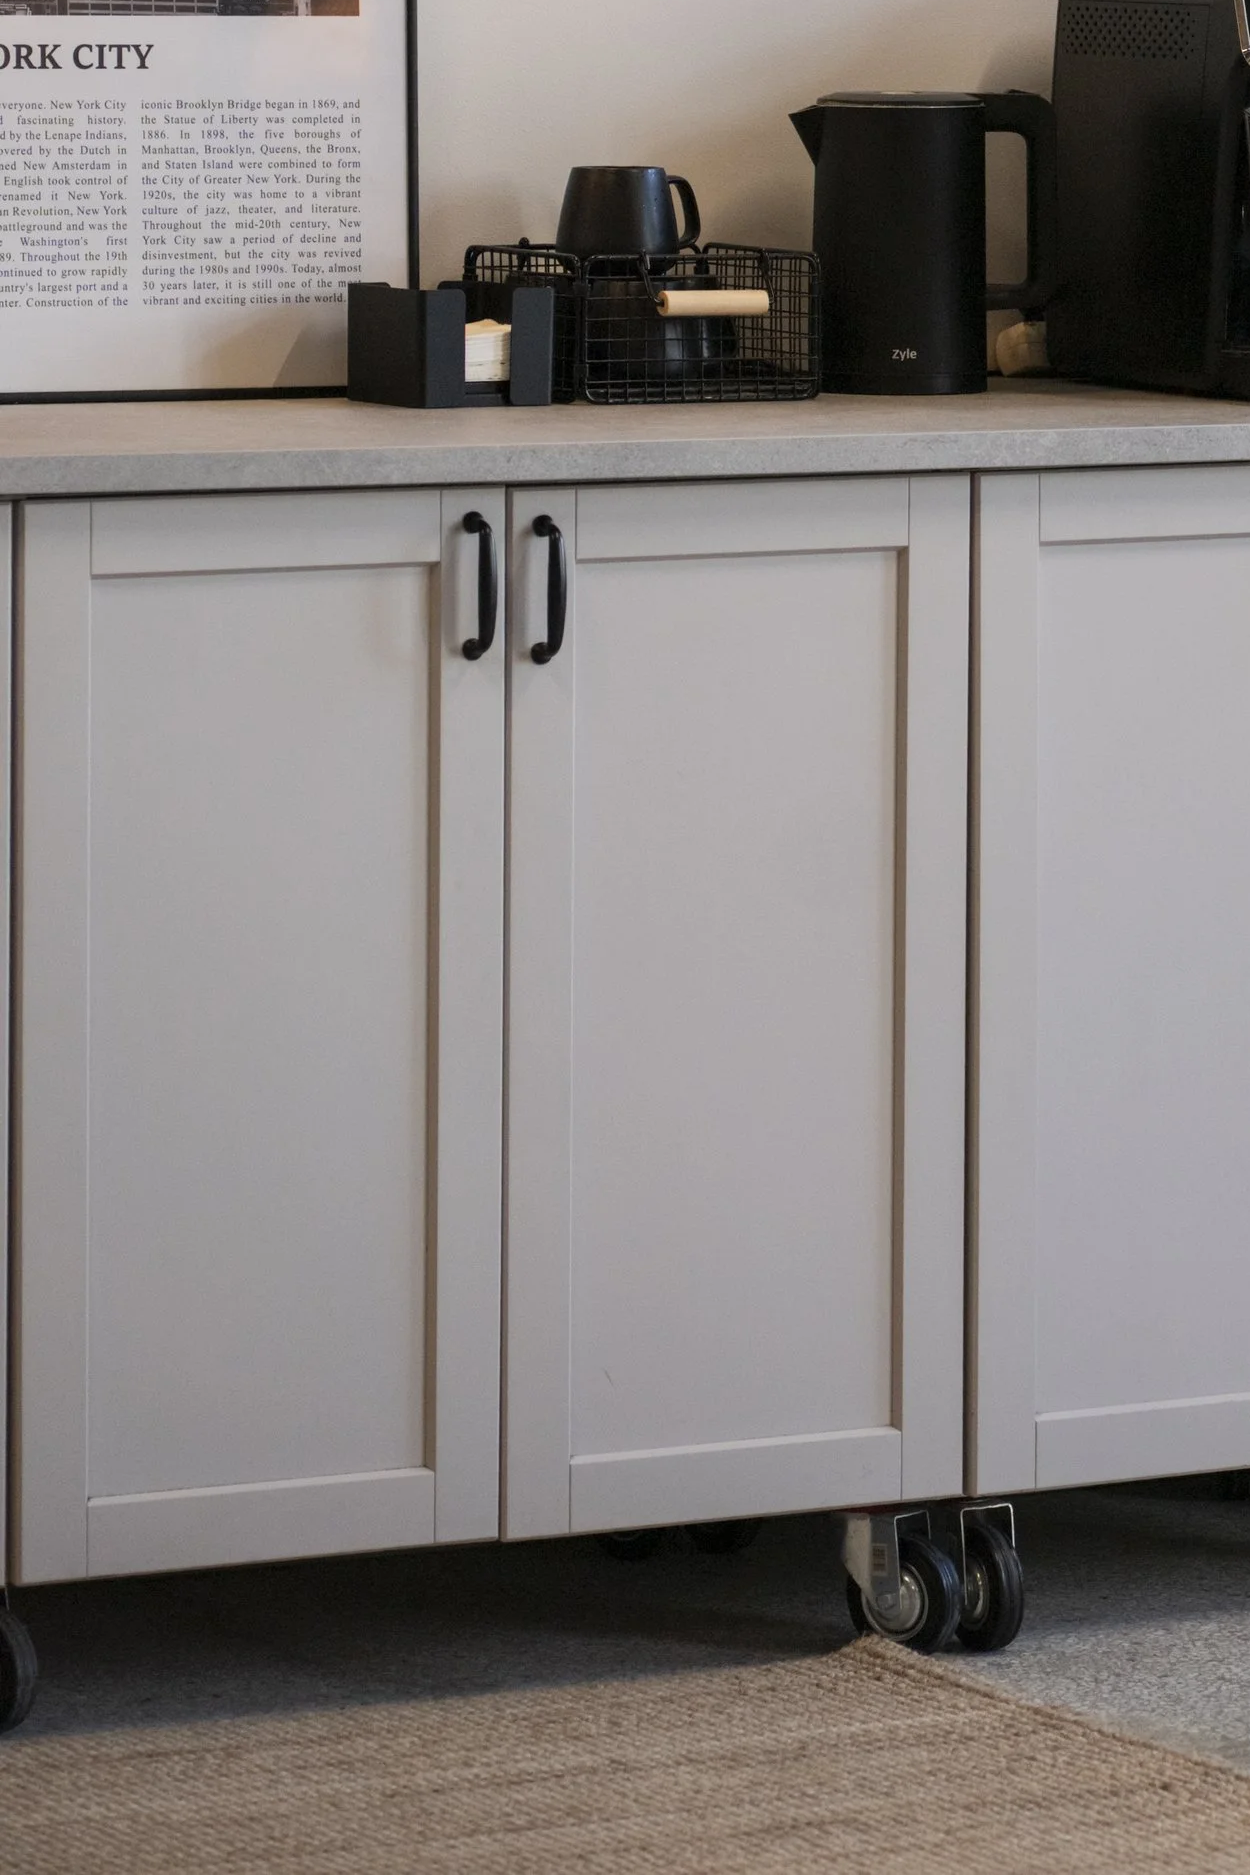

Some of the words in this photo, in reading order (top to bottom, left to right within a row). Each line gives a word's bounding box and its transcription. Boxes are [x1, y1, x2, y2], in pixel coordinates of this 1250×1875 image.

[73, 44, 154, 69] CITY
[51, 100, 72, 109] New
[77, 100, 100, 109] York
[104, 100, 126, 111] City
[142, 99, 172, 109] iconic
[176, 99, 223, 111] Brooklyn
[228, 100, 261, 111] Bridge
[265, 99, 294, 111] began
[313, 99, 339, 109] 1869,
[343, 99, 360, 109] and
[18, 115, 74, 127] fascinating
[88, 115, 125, 127] history.
[141, 115, 156, 124] the
[164, 114, 196, 124] Statue
[203, 114, 215, 124] of
[221, 114, 258, 126] Liberty
[292, 114, 343, 126] completed
[10, 130, 21, 142] by
[26, 130, 41, 140] the
[45, 130, 81, 142] Lenape
[86, 130, 126, 141] Indians,
[143, 130, 169, 139] 1886.
[202, 129, 228, 140] 1898,
[239, 129, 254, 139] the
[265, 129, 284, 139] five
[295, 129, 340, 141] boroughs
[39, 145, 51, 157] by
[58, 145, 73, 155] the
[80, 145, 110, 155] Dutch
[142, 145, 198, 156] Manhattan,
[205, 144, 255, 156] Brooklyn,
[260, 144, 300, 155] Queens,
[306, 144, 321, 153] the
[328, 144, 360, 154] Bronx,
[24, 161, 46, 170] New
[52, 160, 110, 170] Amsterdam
[142, 160, 159, 170] and
[165, 160, 196, 170] Staten
[203, 160, 233, 169] Island
[268, 159, 316, 169] combined
[338, 159, 360, 168] form
[4, 176, 43, 188] English
[48, 176, 70, 185] took
[75, 175, 111, 185] control
[117, 175, 128, 185] of
[142, 175, 157, 185] the
[162, 175, 184, 187] City
[189, 175, 200, 185] of
[204, 174, 242, 184] Greater
[247, 174, 269, 184] New
[274, 174, 300, 183] York.
[306, 174, 341, 185] During
[346, 173, 360, 183] the
[68, 191, 90, 201] New
[100, 191, 127, 200] York.
[144, 190, 175, 200] 1920s,
[184, 190, 199, 200] the
[207, 190, 225, 201] city
[260, 189, 287, 199] home
[326, 189, 360, 198] vibrant
[13, 206, 73, 217] Revolution,
[77, 206, 99, 216] New
[103, 205, 127, 215] York
[142, 205, 178, 215] culture
[206, 205, 229, 216] jazz,
[239, 205, 276, 214] theater,
[285, 204, 302, 213] and
[312, 204, 360, 213] literature.
[66, 221, 84, 231] and
[112, 221, 127, 230] the
[142, 220, 201, 232] Throughout
[211, 220, 226, 229] the
[235, 219, 280, 229] mid-20th
[290, 221, 330, 230] century,
[339, 218, 361, 228] New
[20, 237, 88, 248] Washington's
[107, 236, 127, 245] first
[143, 235, 166, 245] York
[174, 235, 195, 247] City
[243, 234, 275, 246] period
[283, 233, 294, 244] of
[300, 234, 336, 243] decline
[344, 233, 361, 243] and
[20, 252, 80, 264] Throughout
[85, 251, 100, 261] the
[106, 251, 127, 261] 19th
[142, 250, 216, 261] disinvestment,
[225, 250, 240, 259] but
[249, 249, 263, 259] the
[271, 249, 289, 261] city
[324, 248, 361, 260] revived
[61, 269, 86, 279] grow
[91, 266, 127, 278] rapidly
[142, 265, 175, 277] during
[180, 265, 195, 275] the
[200, 265, 228, 274] 1980s
[233, 264, 250, 274] and
[256, 264, 287, 274] 1990s.
[292, 264, 324, 275] Today,
[329, 263, 361, 273] almost
[38, 282, 72, 294] largest
[76, 283, 96, 294] port
[101, 281, 118, 291] and
[143, 281, 154, 290] 30
[160, 283, 187, 293] years
[194, 280, 219, 291] later,
[252, 279, 272, 289] still
[301, 279, 312, 288] of
[317, 278, 332, 288] the
[26, 297, 93, 307] Construction
[113, 296, 128, 306] the
[143, 296, 178, 305] vibrant
[183, 295, 201, 305] and
[205, 294, 246, 306] exciting
[250, 294, 278, 306] cities
[295, 293, 310, 303] the
[314, 292, 346, 305] world.
[892, 348, 917, 361] Zyle
